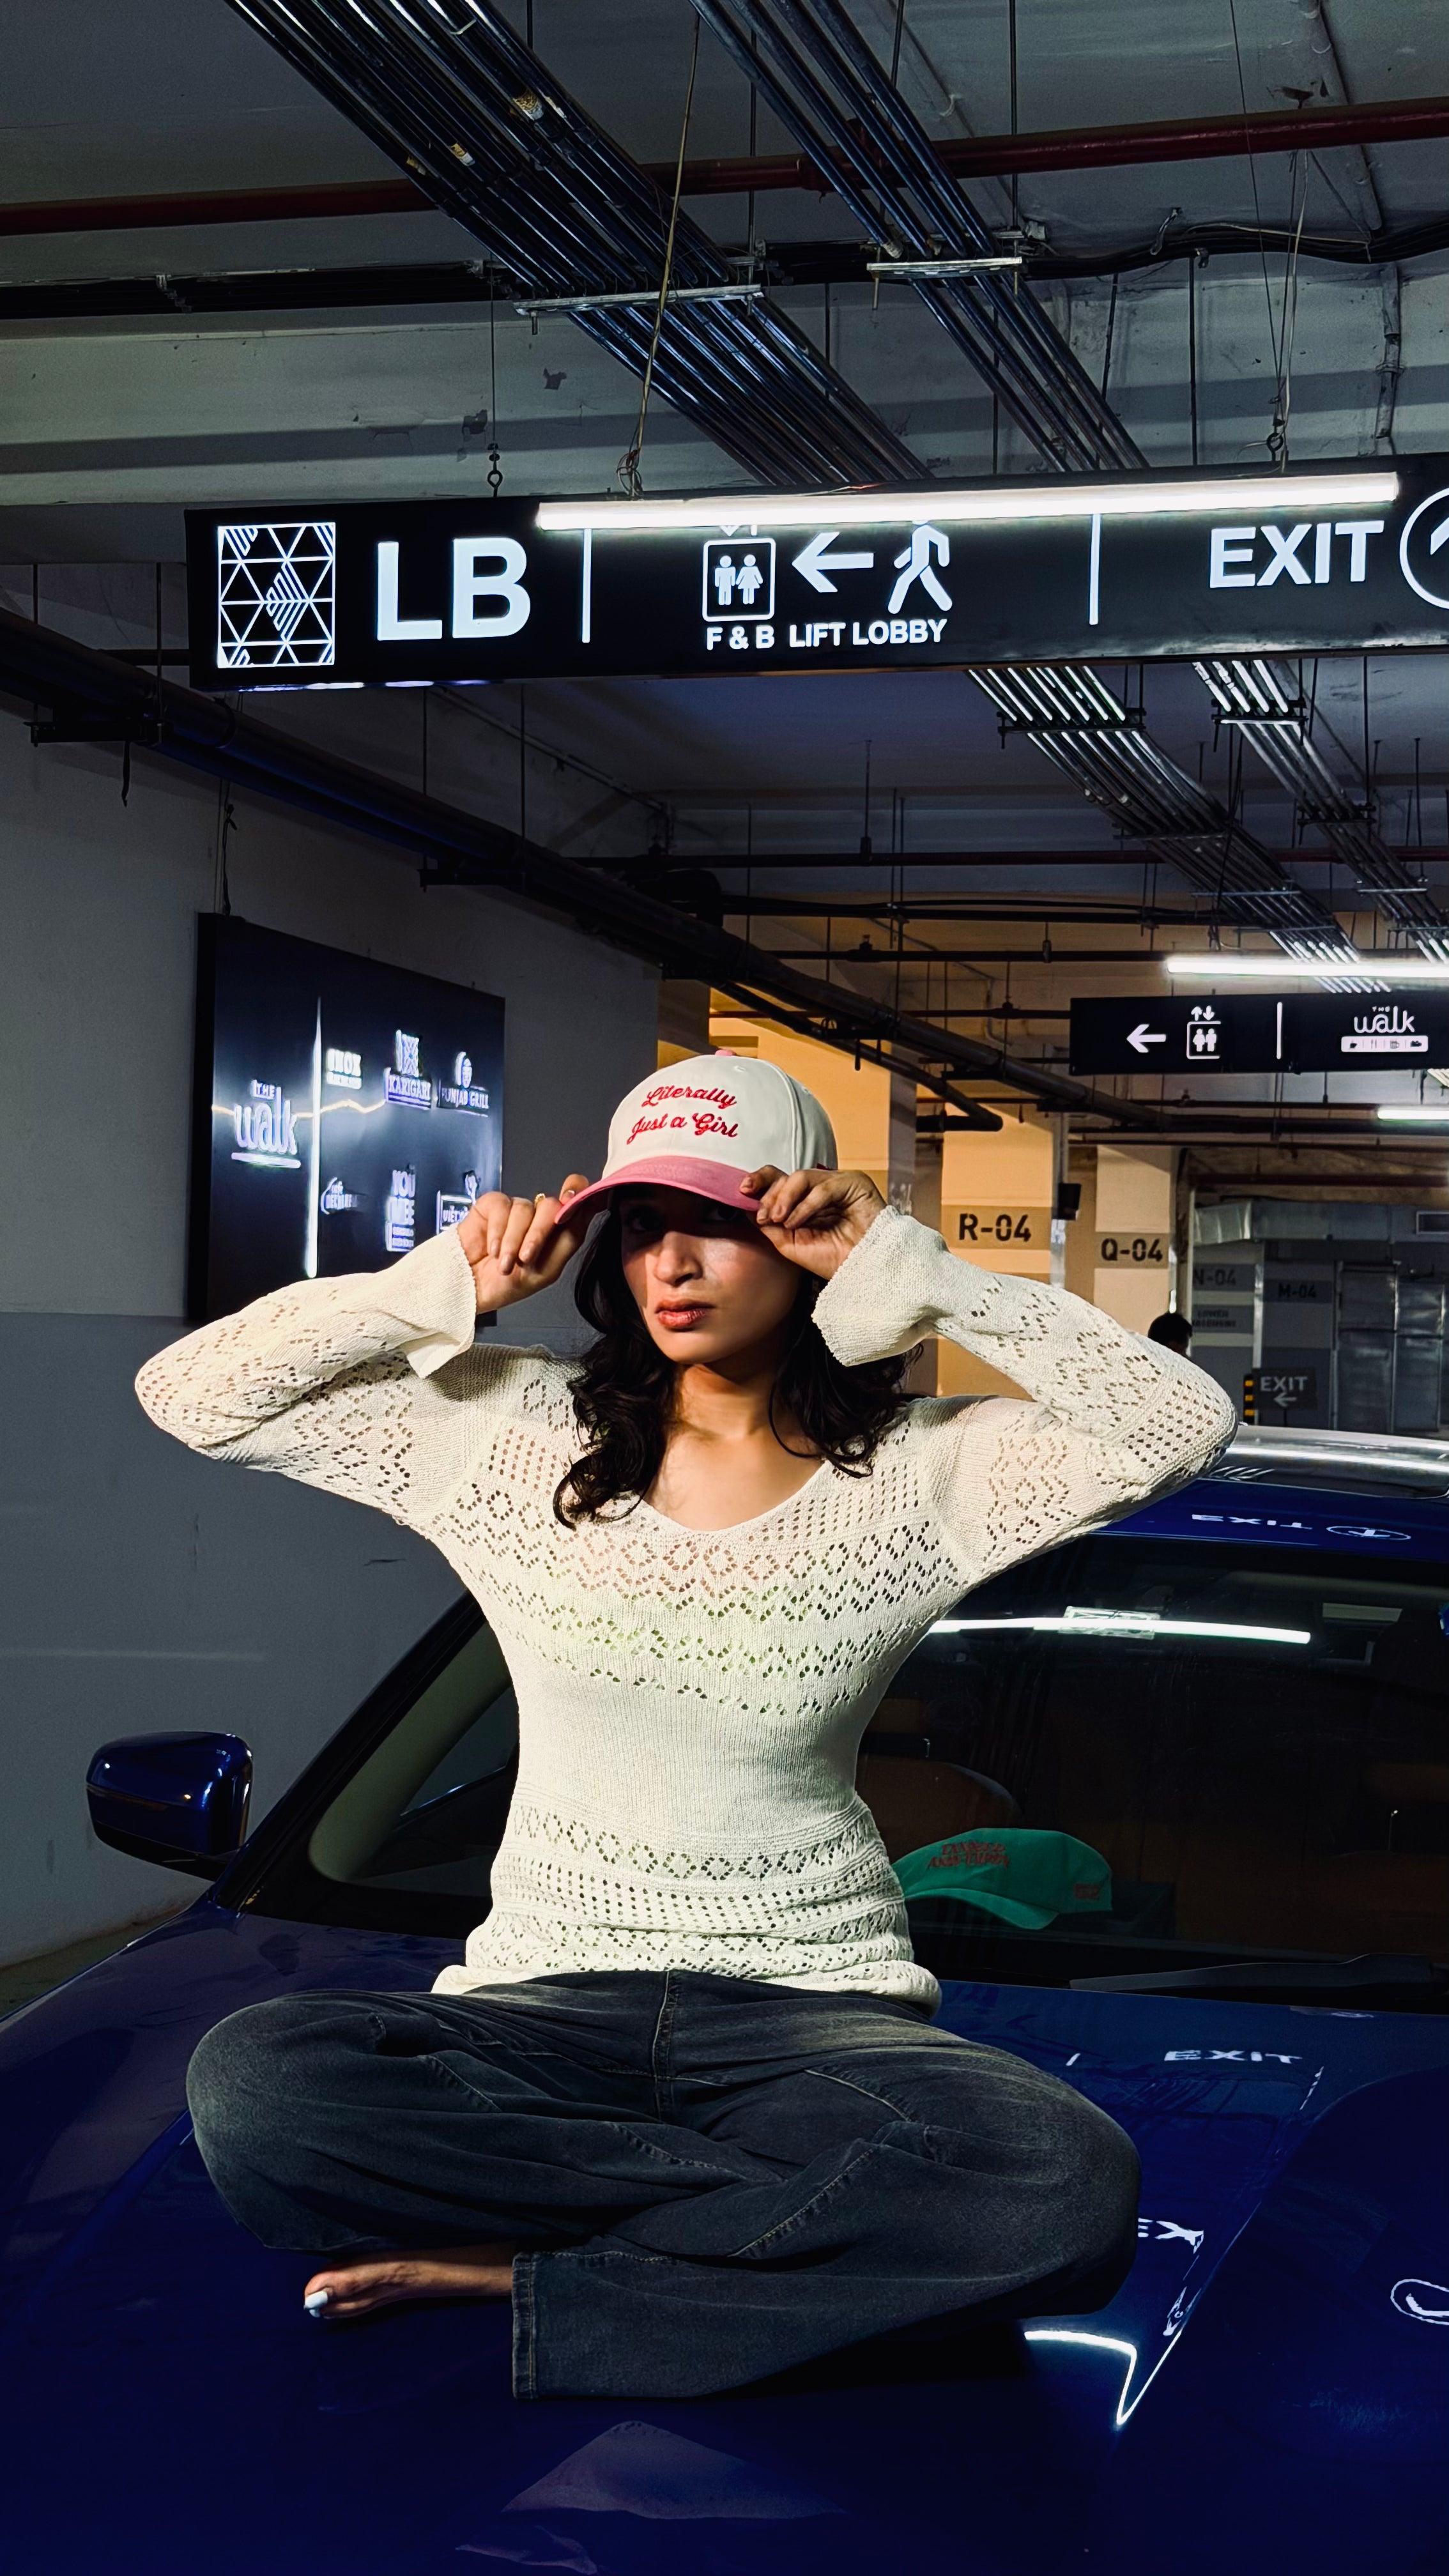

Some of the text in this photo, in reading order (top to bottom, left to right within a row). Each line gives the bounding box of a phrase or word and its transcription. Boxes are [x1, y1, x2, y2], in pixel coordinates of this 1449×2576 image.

[1210, 520, 1384, 588] EXIT
[376, 537, 531, 641] LB
[706, 618, 947, 650] F & B LIFT LOBBY
[1353, 1006, 1416, 1034] walk
[254, 1080, 275, 1099] THE
[387, 1075, 432, 1101] KARIGARI
[469, 1090, 489, 1110] GRILL
[641, 1085, 737, 1110] Literally
[234, 1086, 298, 1155] walk
[671, 1116, 687, 1128] a
[692, 1112, 739, 1138] Girl
[959, 1213, 1031, 1242] R-04
[1101, 1238, 1163, 1262] Q-04
[1193, 1268, 1237, 1286] N-04
[1278, 1282, 1317, 1298] M-04
[1260, 1376, 1308, 1392] EXIT
[1164, 2050, 1303, 2064] EXIT
